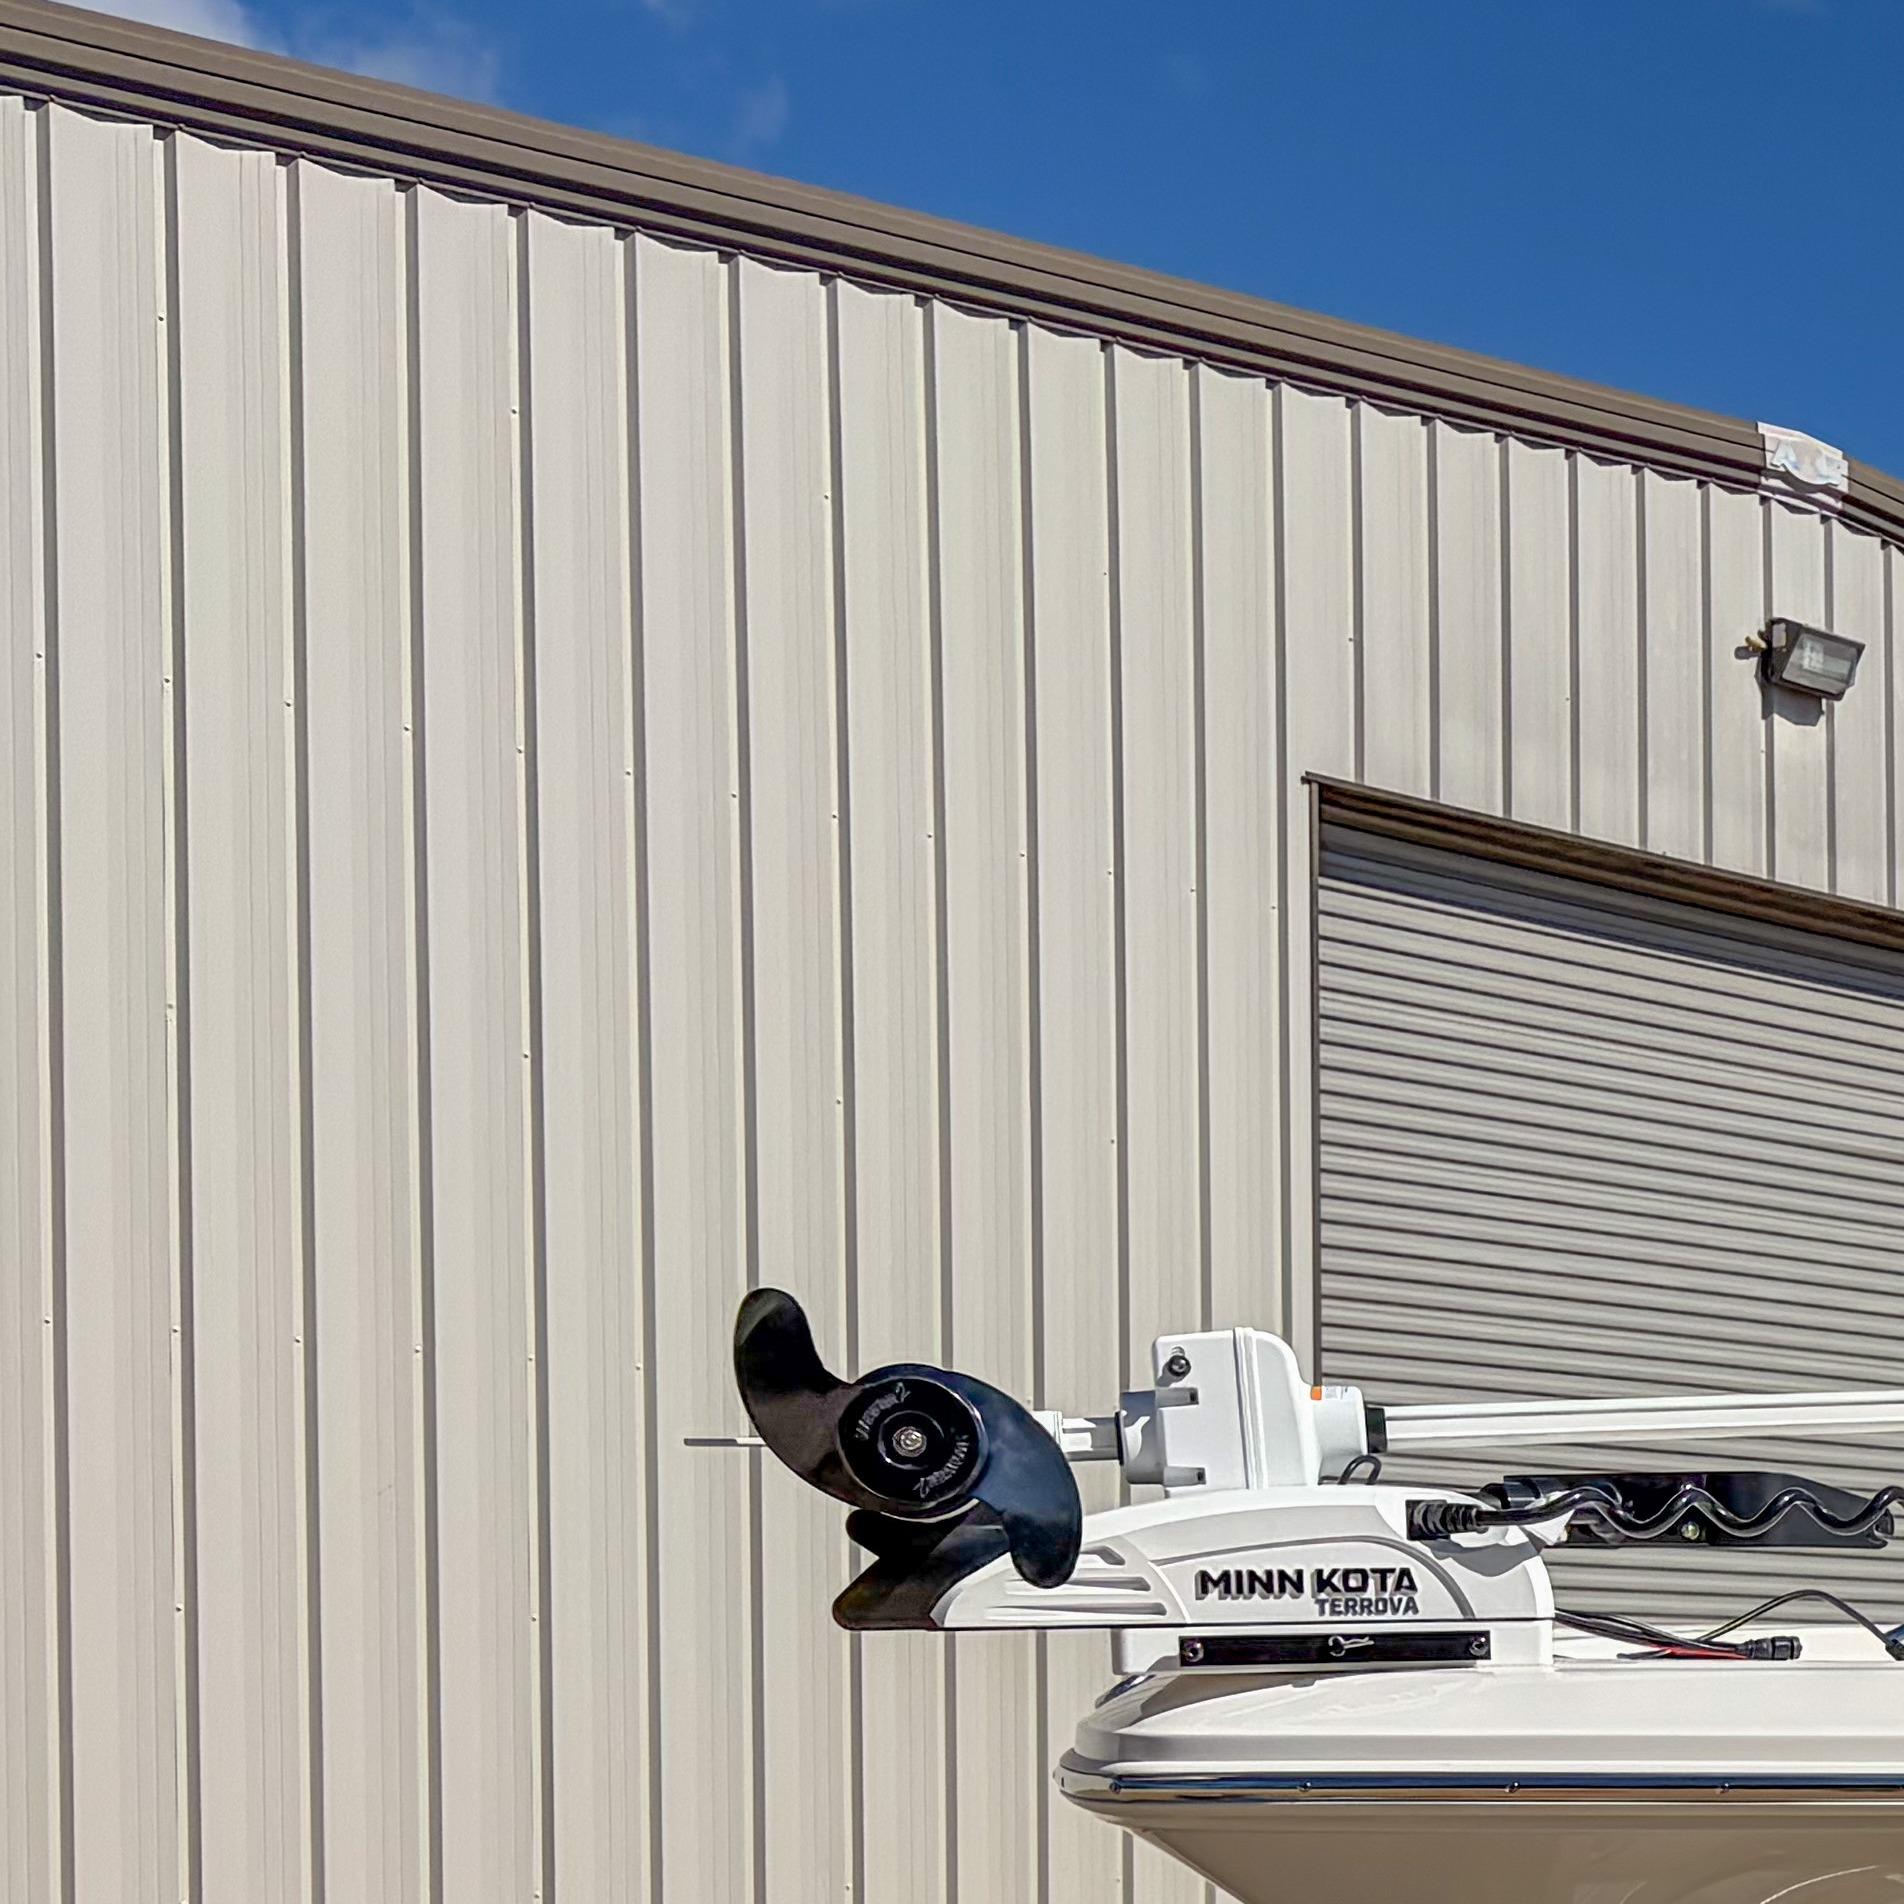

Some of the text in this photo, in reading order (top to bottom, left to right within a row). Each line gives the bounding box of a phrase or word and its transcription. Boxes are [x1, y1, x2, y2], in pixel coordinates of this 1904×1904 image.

[1195, 1567, 1419, 1601] MINN KOTA
[1314, 1597, 1420, 1617] TERROVA
